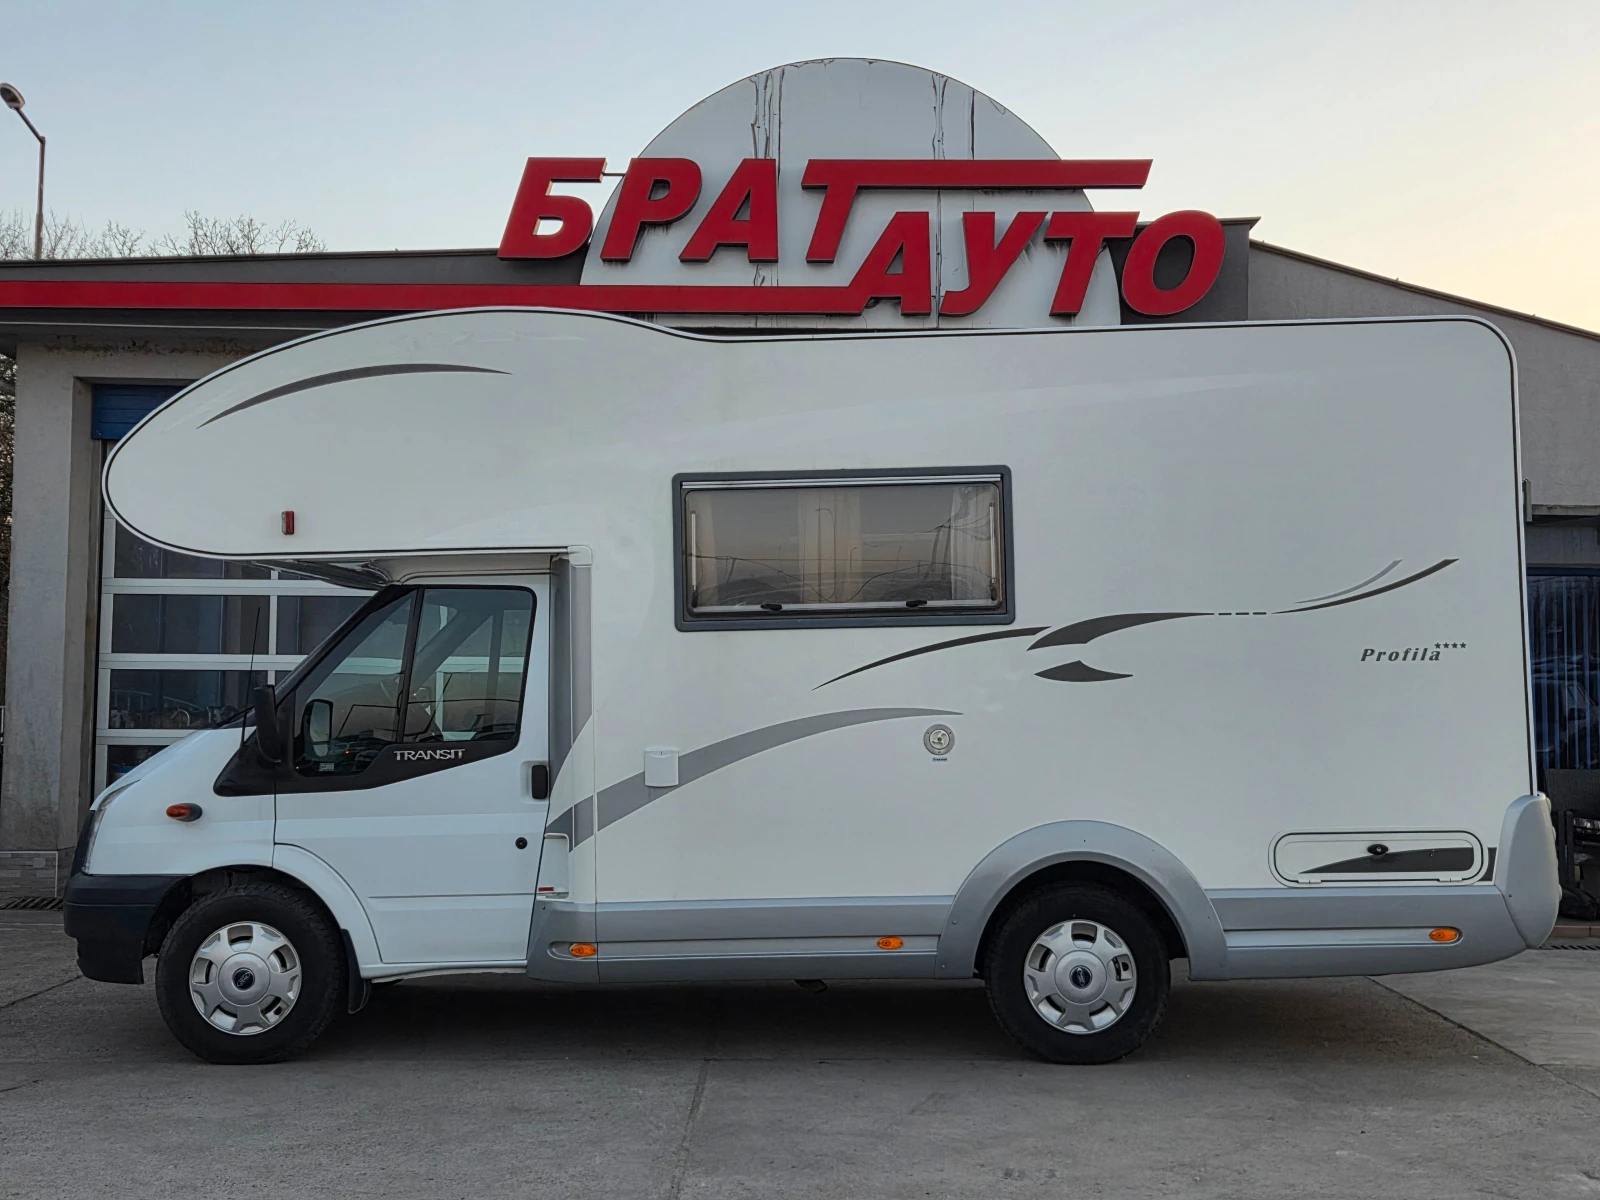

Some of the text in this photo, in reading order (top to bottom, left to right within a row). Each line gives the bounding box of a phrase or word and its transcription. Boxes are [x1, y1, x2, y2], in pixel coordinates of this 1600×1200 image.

[497, 157, 1153, 263] БРАТ
[846, 210, 1226, 317] АУТО
[1360, 647, 1441, 662] Profila
[393, 748, 466, 761] TRANSIT
